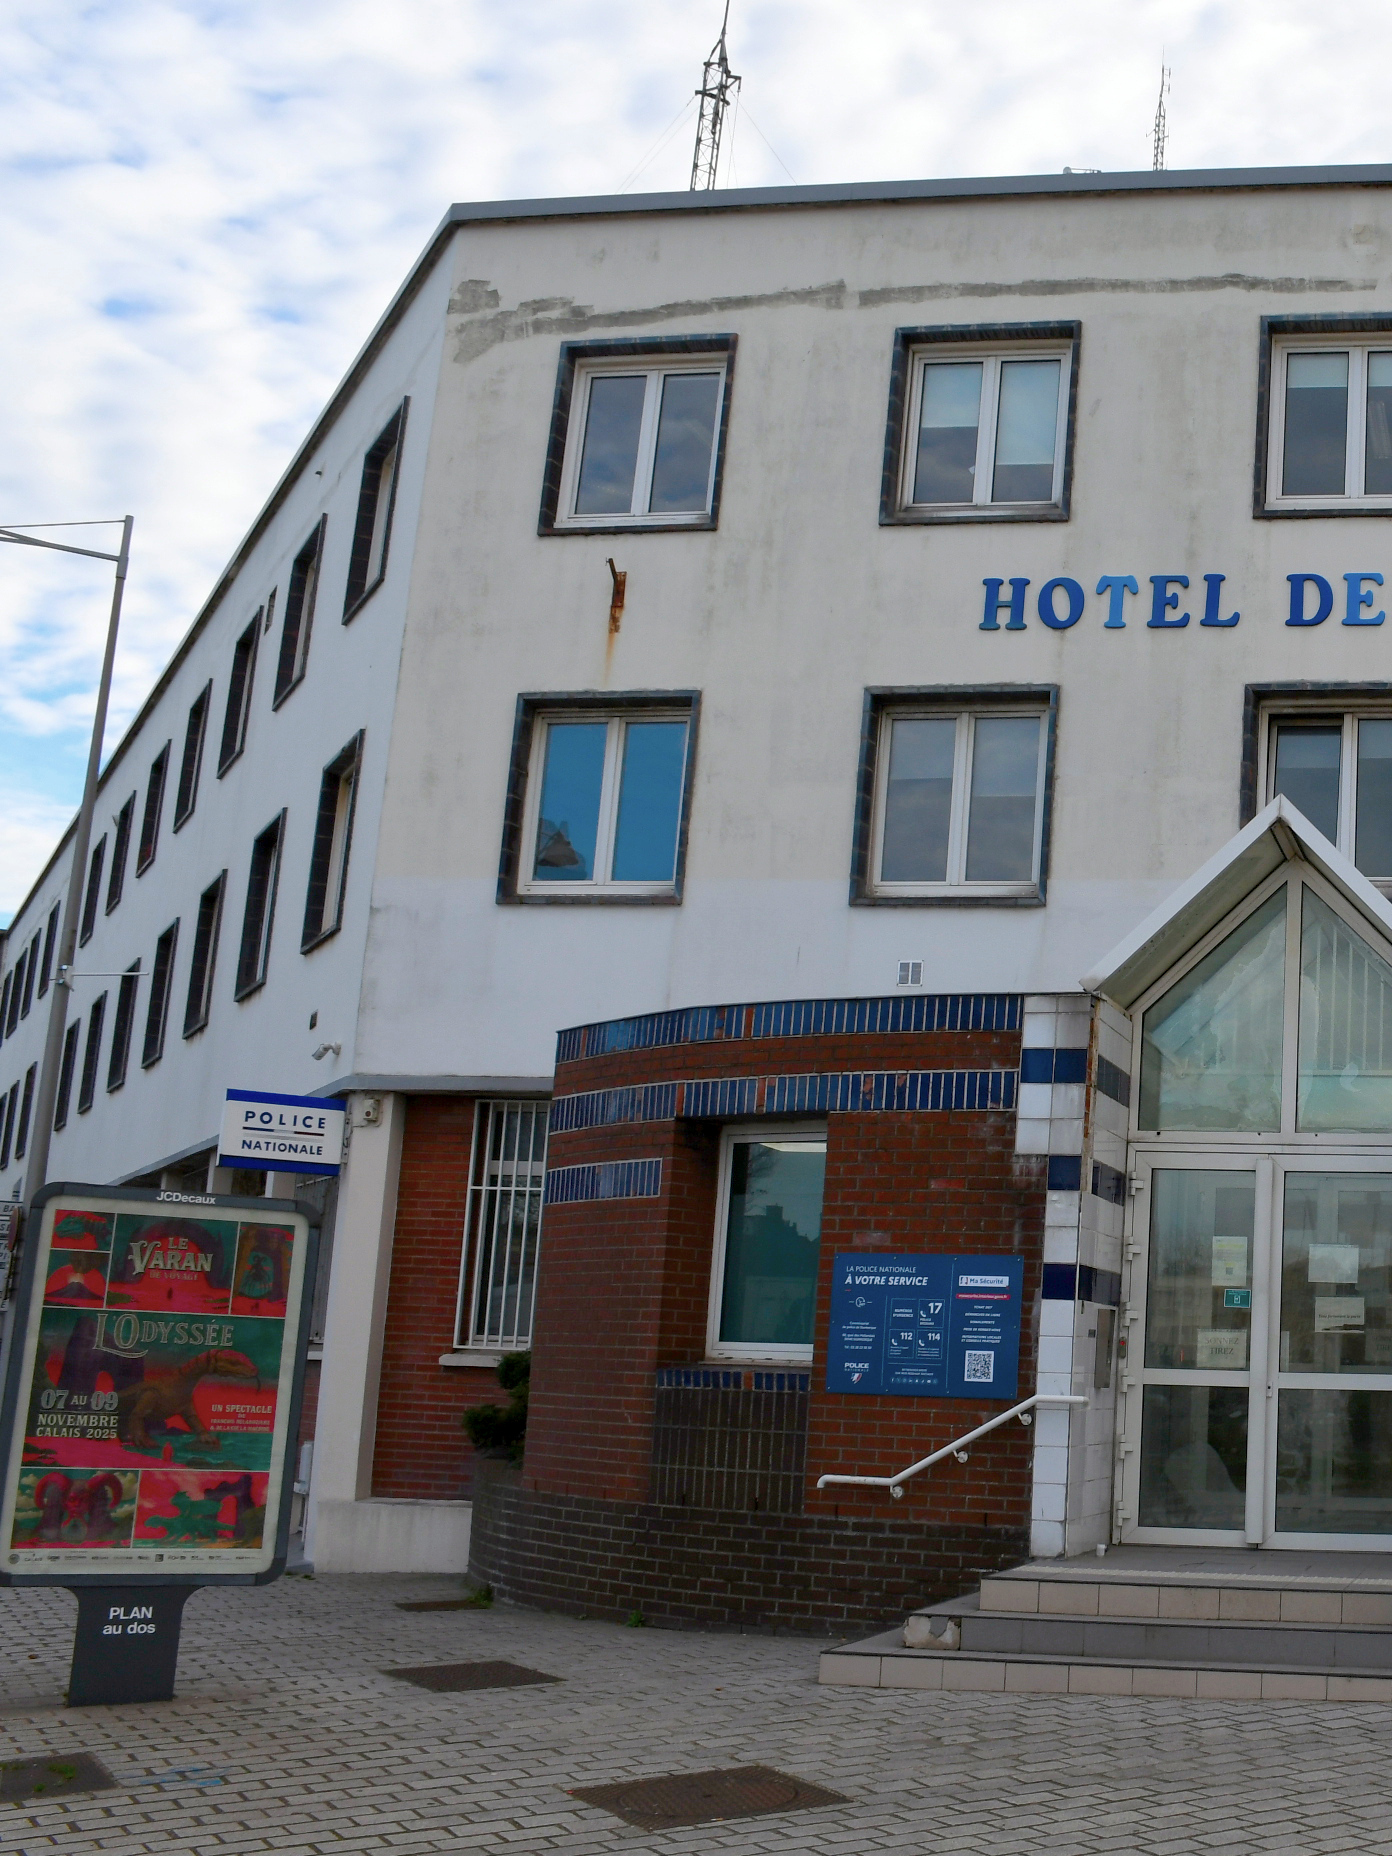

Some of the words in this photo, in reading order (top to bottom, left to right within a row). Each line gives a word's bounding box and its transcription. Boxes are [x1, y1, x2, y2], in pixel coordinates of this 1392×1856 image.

[978, 573, 1241, 631] HOTEL
[1284, 572, 1386, 627] DE
[244, 1110, 326, 1129] POLICE
[241, 1139, 323, 1156] NATIONALE
[156, 1191, 217, 1204] JCDecaux
[168, 1237, 189, 1250] LE
[128, 1240, 214, 1276] VARAN
[846, 1265, 855, 1273] LA
[855, 1265, 878, 1273] POLICE
[879, 1266, 917, 1274] NATIONALE
[844, 1273, 853, 1285] À
[855, 1275, 887, 1285] VOTRE
[888, 1276, 929, 1286] SERVICE
[928, 1302, 943, 1314] 17
[900, 1332, 913, 1341] 112
[927, 1332, 941, 1341] 114
[1209, 1347, 1235, 1355] TIREZ
[40, 1389, 70, 1410] 07
[70, 1395, 88, 1406] AU
[90, 1390, 119, 1411] 09
[211, 1404, 223, 1413] UN
[225, 1404, 273, 1414] SPECTACLE
[37, 1413, 119, 1427] NOVEMBRE
[36, 1427, 81, 1438] CALAIS
[86, 1428, 118, 1439] 2025
[109, 1606, 153, 1620] PLAN
[102, 1623, 123, 1635] au
[127, 1621, 156, 1634] dos
